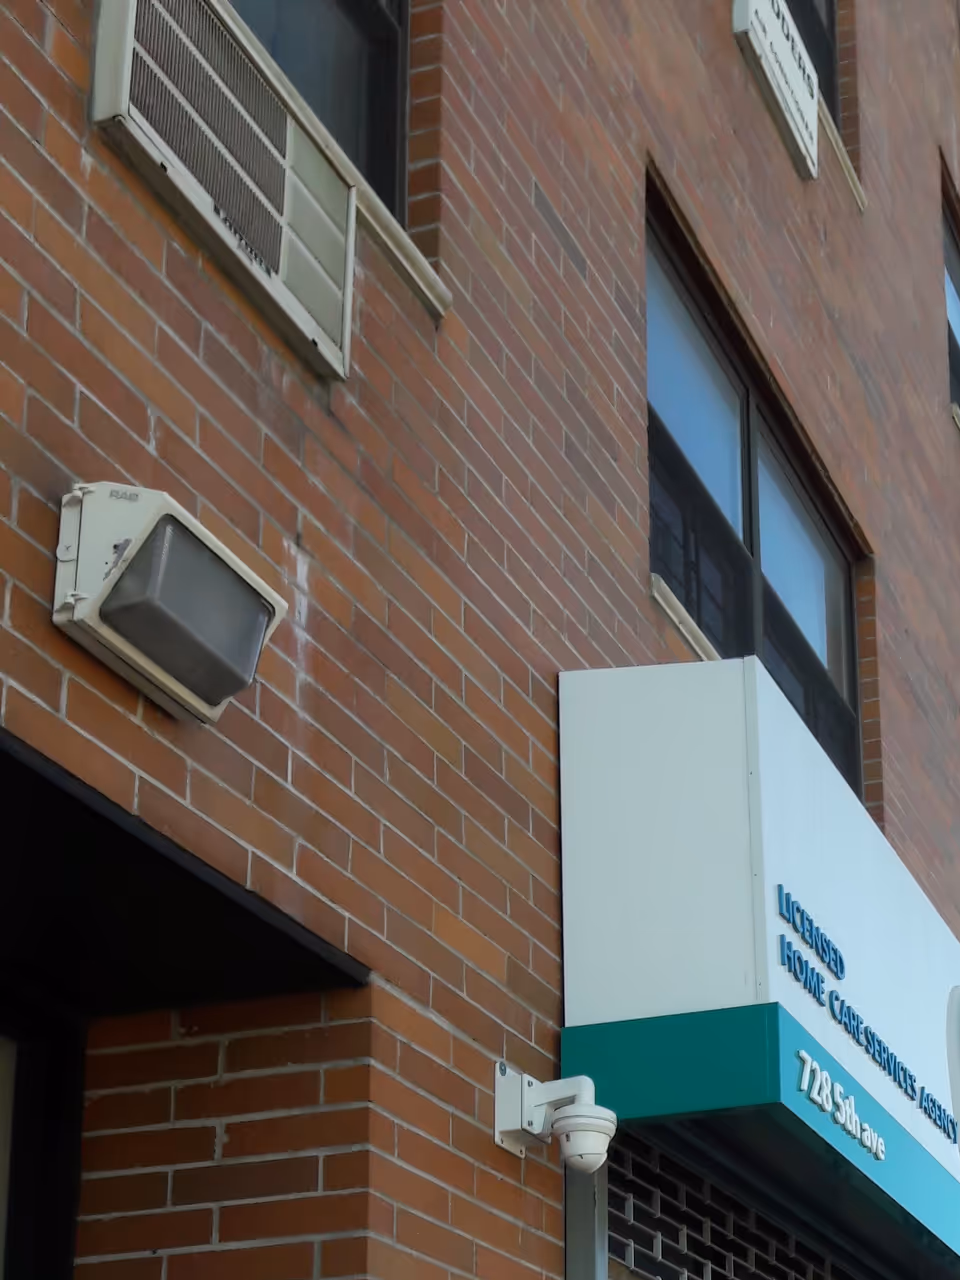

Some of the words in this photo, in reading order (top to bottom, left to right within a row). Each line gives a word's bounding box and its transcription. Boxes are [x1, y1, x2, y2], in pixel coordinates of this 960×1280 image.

[777, 884, 846, 981] LICENSED
[780, 934, 826, 1007] HOME
[828, 990, 865, 1047] CARE
[864, 1026, 917, 1102] SERVICES
[919, 1087, 958, 1145] AGENCY
[797, 1049, 832, 1113] 728
[832, 1082, 862, 1140] 5th
[860, 1121, 886, 1161] ave
